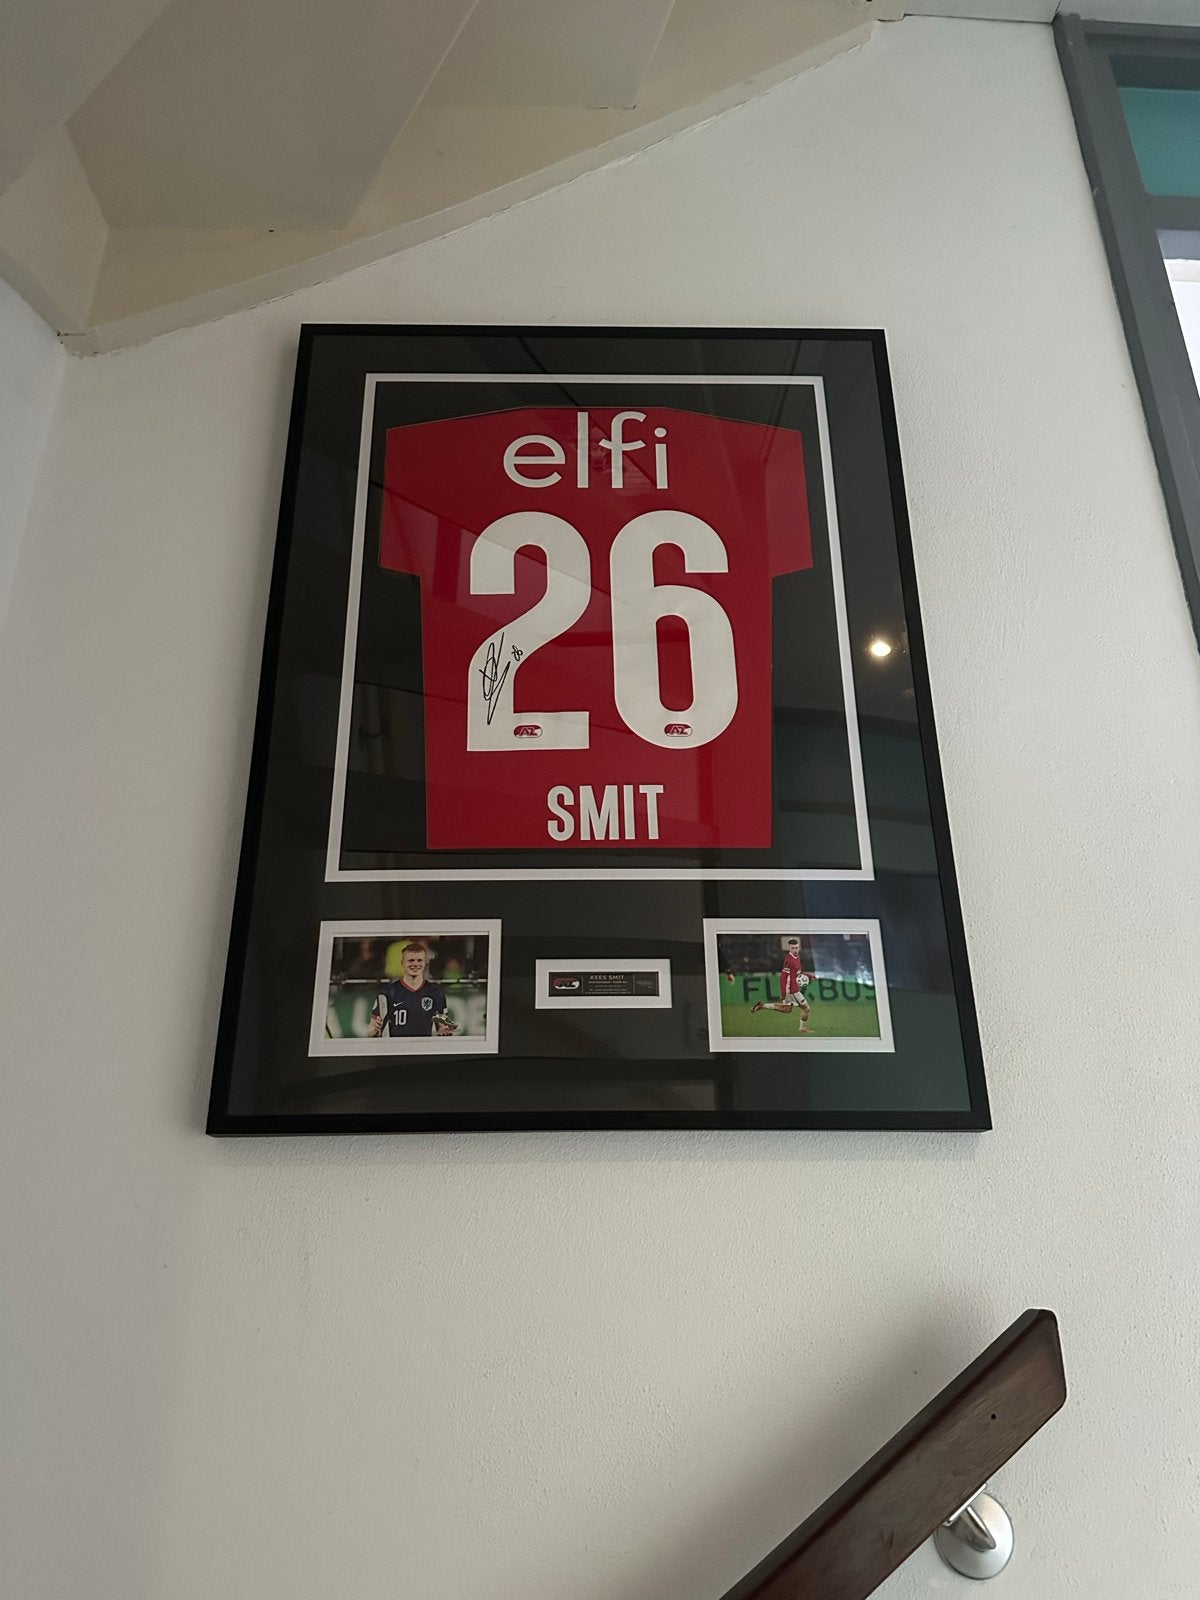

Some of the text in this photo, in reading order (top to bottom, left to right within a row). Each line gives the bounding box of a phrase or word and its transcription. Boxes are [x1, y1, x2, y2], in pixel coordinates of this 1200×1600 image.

[503, 411, 668, 489] elfi
[467, 510, 738, 751] 26
[517, 726, 541, 738] AZ
[667, 725, 690, 736] AZ
[547, 784, 664, 841] SMIT
[743, 977, 875, 1001] FLBU
[393, 1009, 407, 1026] 10
